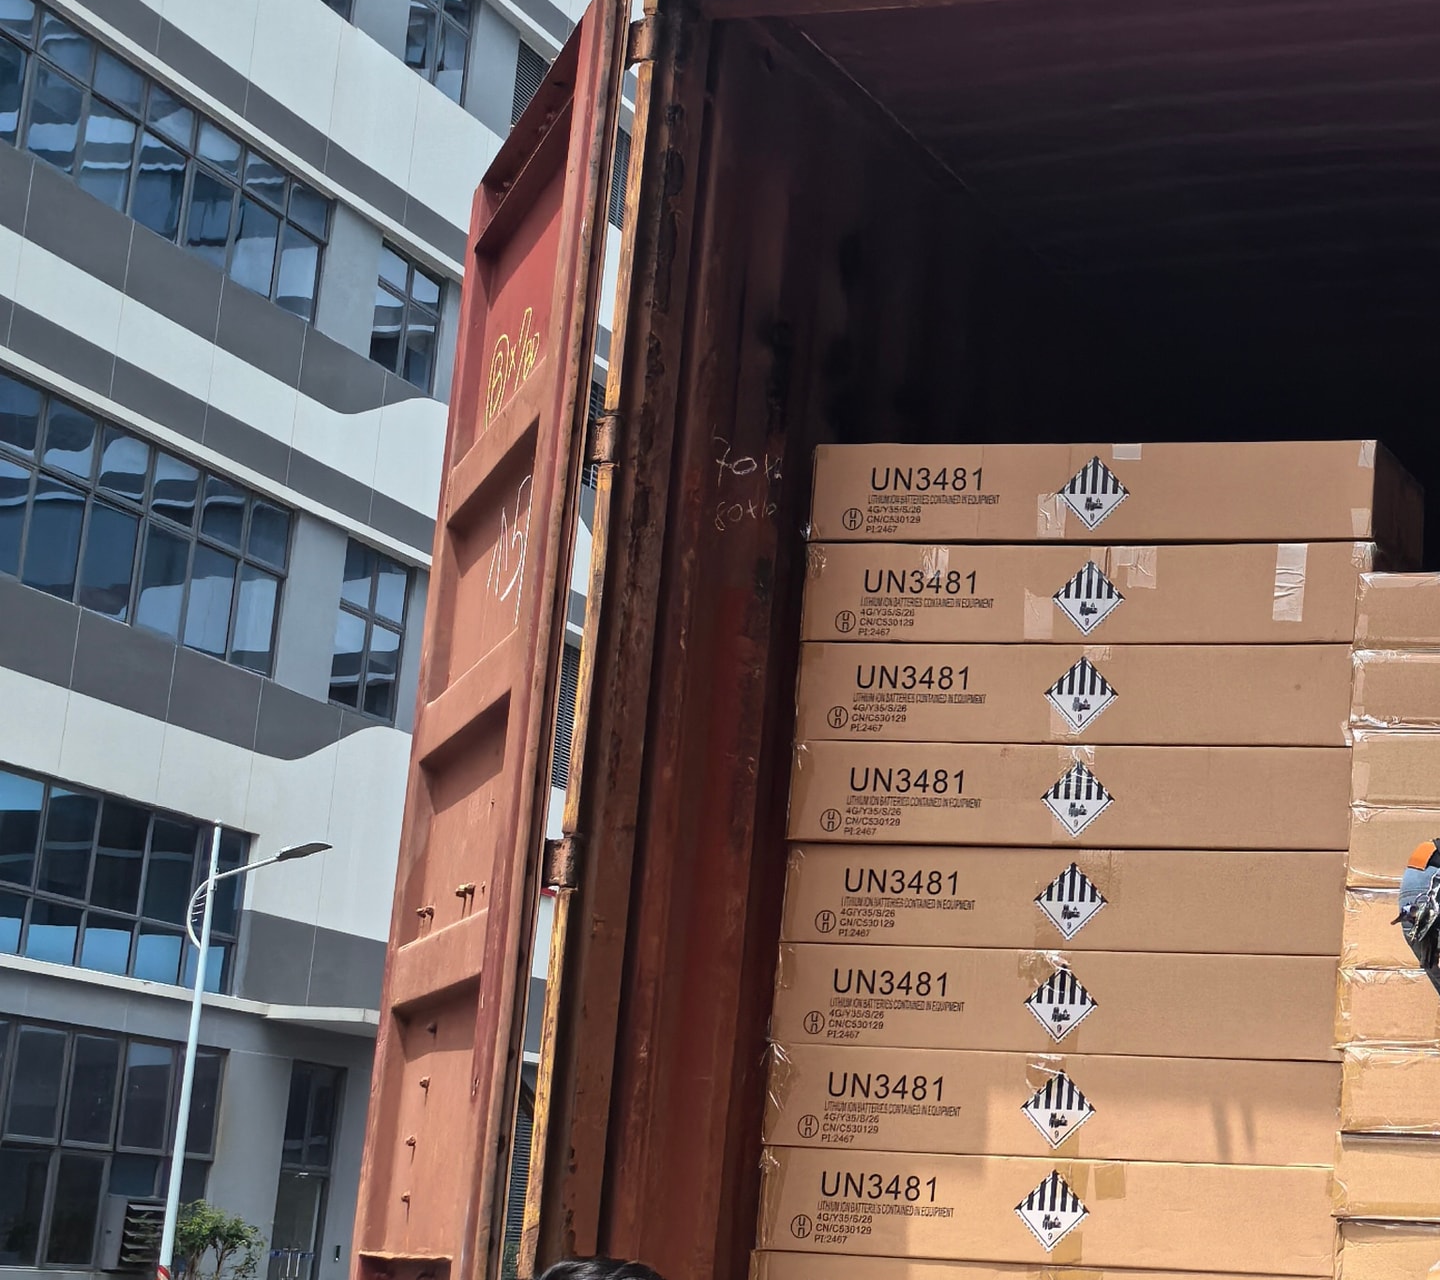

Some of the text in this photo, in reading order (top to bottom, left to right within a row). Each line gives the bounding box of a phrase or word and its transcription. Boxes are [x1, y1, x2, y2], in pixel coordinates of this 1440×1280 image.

[871, 467, 982, 491] UN3481
[864, 570, 976, 594] UN3481
[857, 665, 969, 690] UN3481
[850, 768, 964, 794] UN3481
[845, 868, 958, 895] UN3481
[833, 969, 947, 996] UN3481
[828, 1072, 943, 1101] UN3481
[821, 1171, 936, 1202] UN3481
